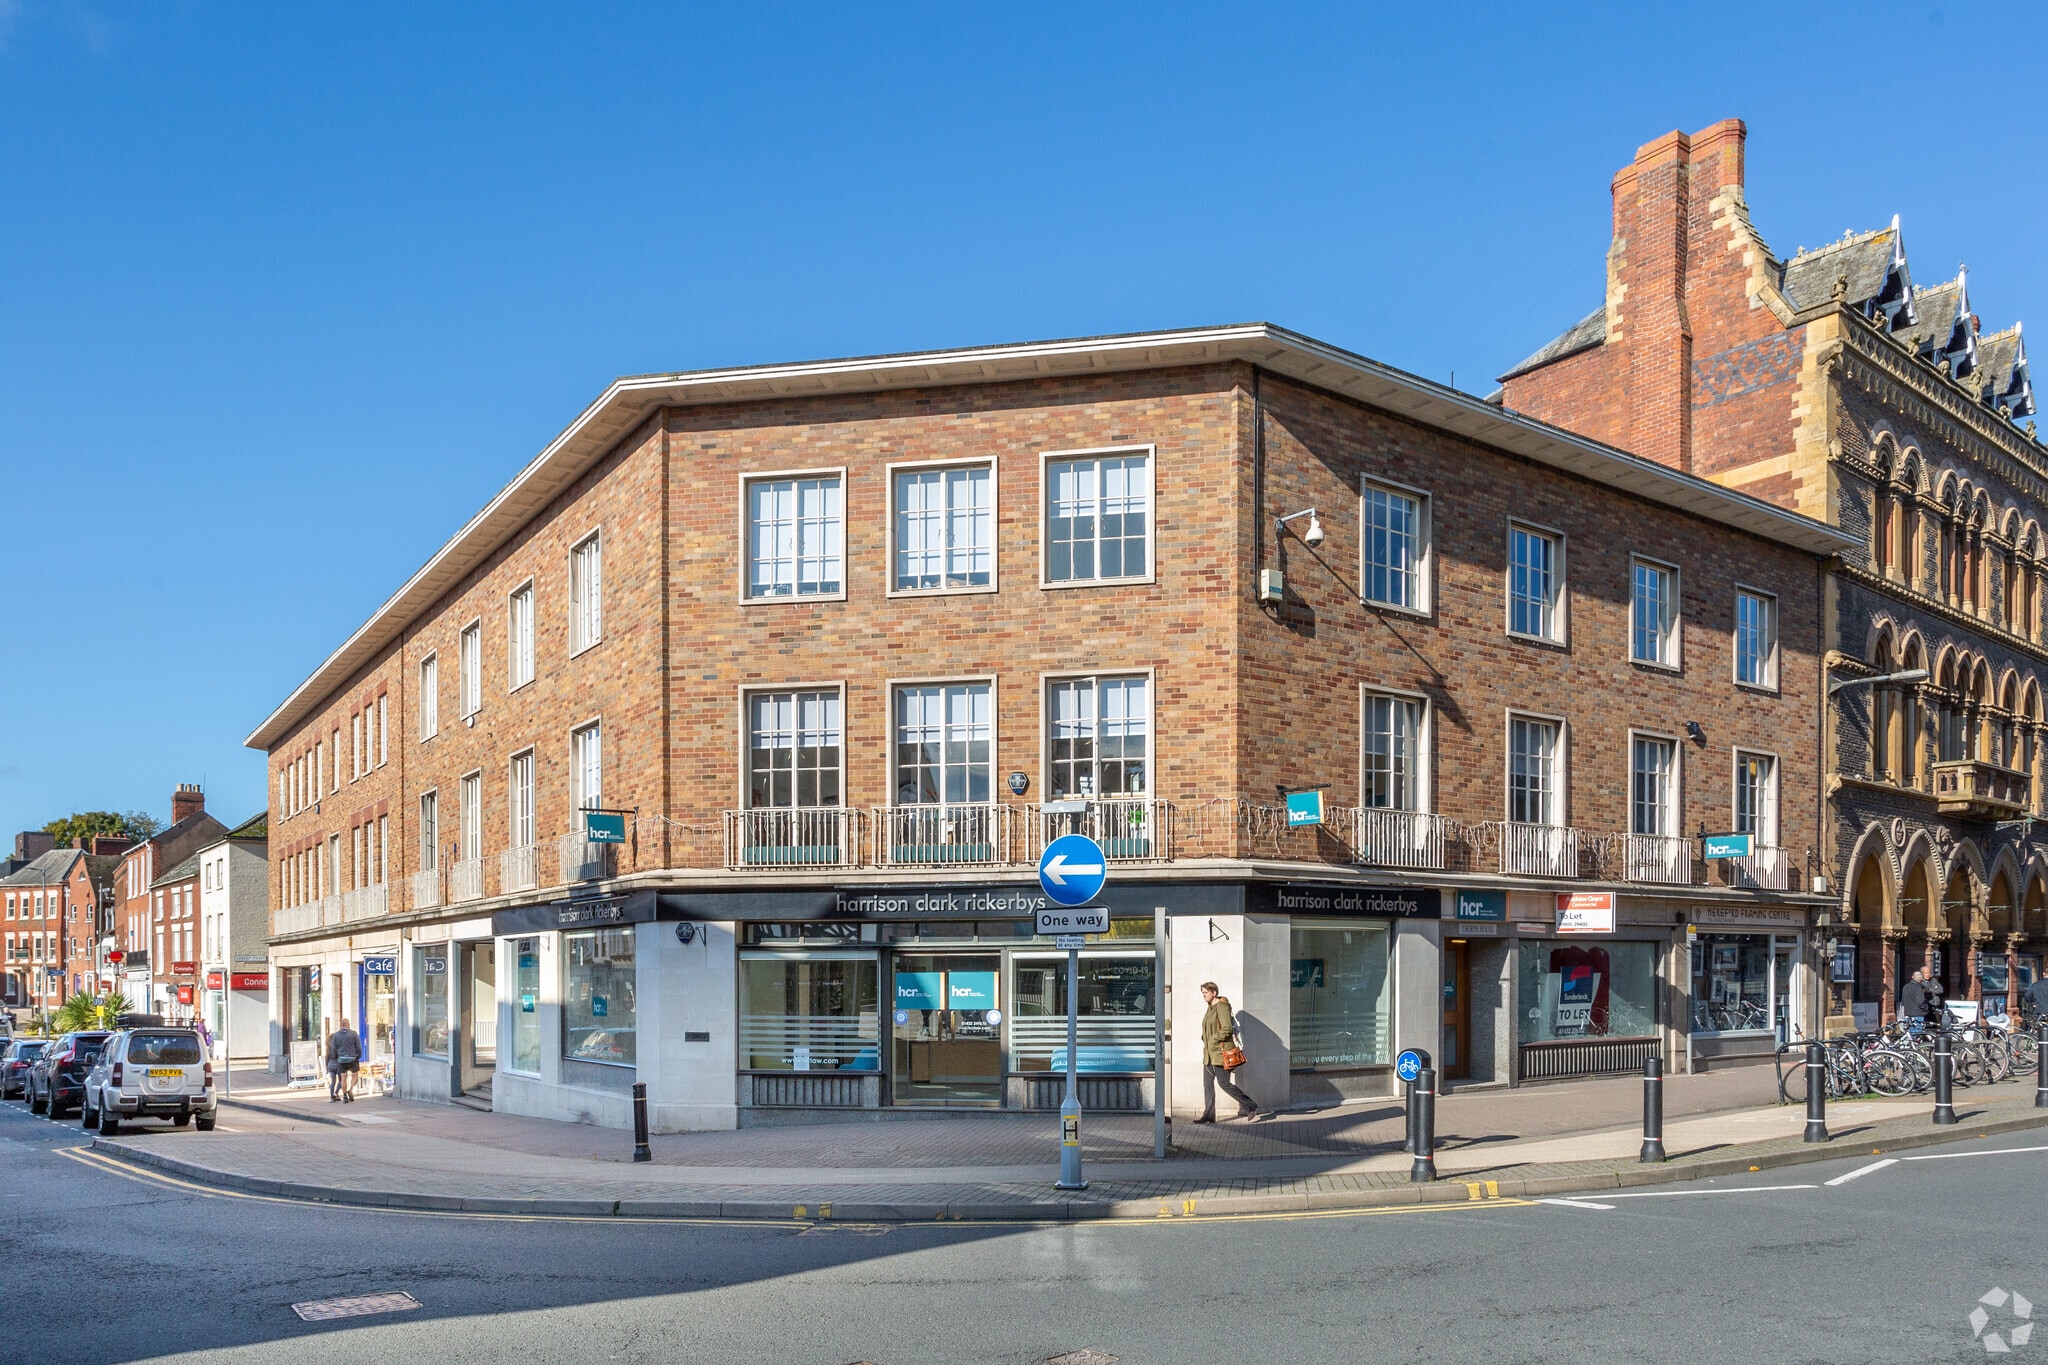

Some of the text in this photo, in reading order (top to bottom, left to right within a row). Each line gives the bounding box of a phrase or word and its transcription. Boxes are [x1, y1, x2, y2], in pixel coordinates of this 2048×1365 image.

[1289, 809, 1307, 821] hcr
[590, 826, 611, 839] hcr
[1708, 843, 1730, 855] hcr
[836, 892, 1046, 915] harrison clark rickerbys
[1277, 889, 1418, 916] harrison clark rickerbys
[1460, 896, 1483, 916] hcr
[558, 908, 580, 923] harrison
[1560, 912, 1582, 920] To Let
[1741, 908, 1767, 919] FRAMING
[1768, 910, 1791, 920] CENTRE
[1041, 914, 1103, 927] One way
[366, 958, 393, 972] Café
[1113, 966, 1149, 974] COVID-19
[898, 986, 918, 997] hcr
[951, 985, 972, 997] hcr
[1559, 1009, 1590, 1020] TO LET
[1307, 1056, 1319, 1066] you
[1320, 1054, 1338, 1064] every
[1340, 1053, 1353, 1063] step
[1355, 1052, 1361, 1061] of
